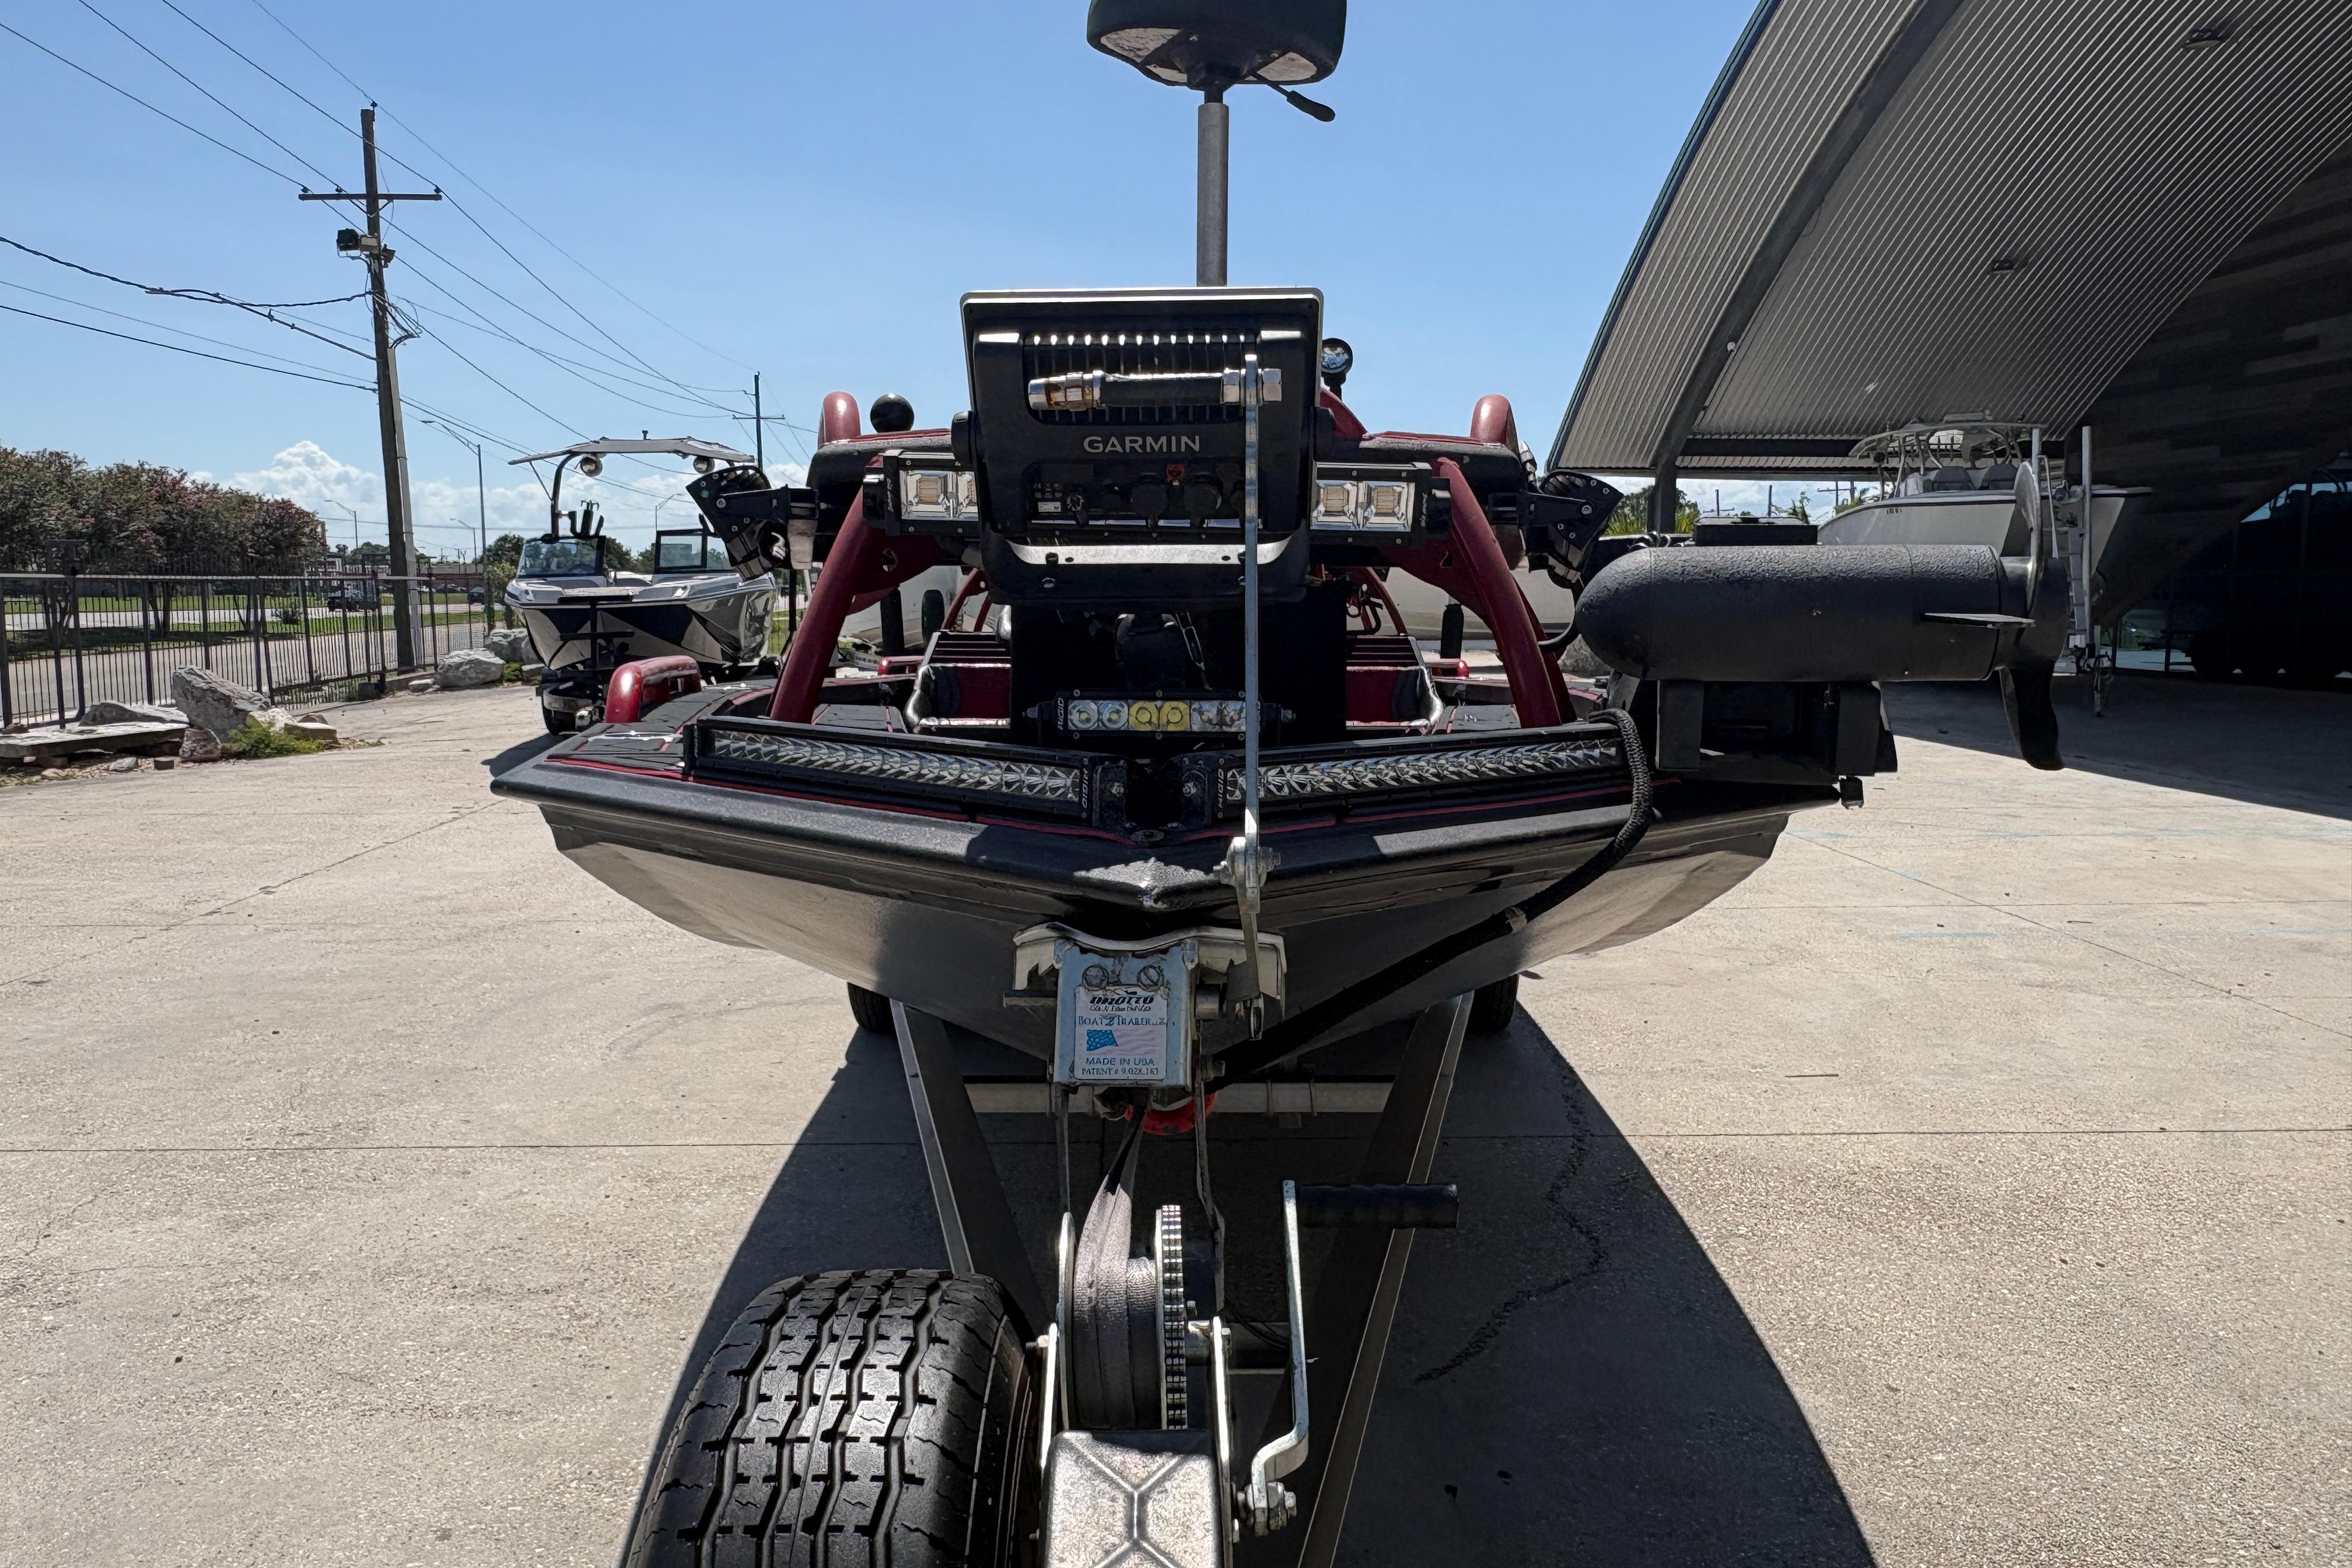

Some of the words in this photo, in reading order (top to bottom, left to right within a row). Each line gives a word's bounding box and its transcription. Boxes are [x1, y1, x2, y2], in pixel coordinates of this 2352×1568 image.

[1083, 435, 1200, 453] GARMIN
[1086, 1058, 1116, 1066] MADE
[1119, 1058, 1130, 1066] IN
